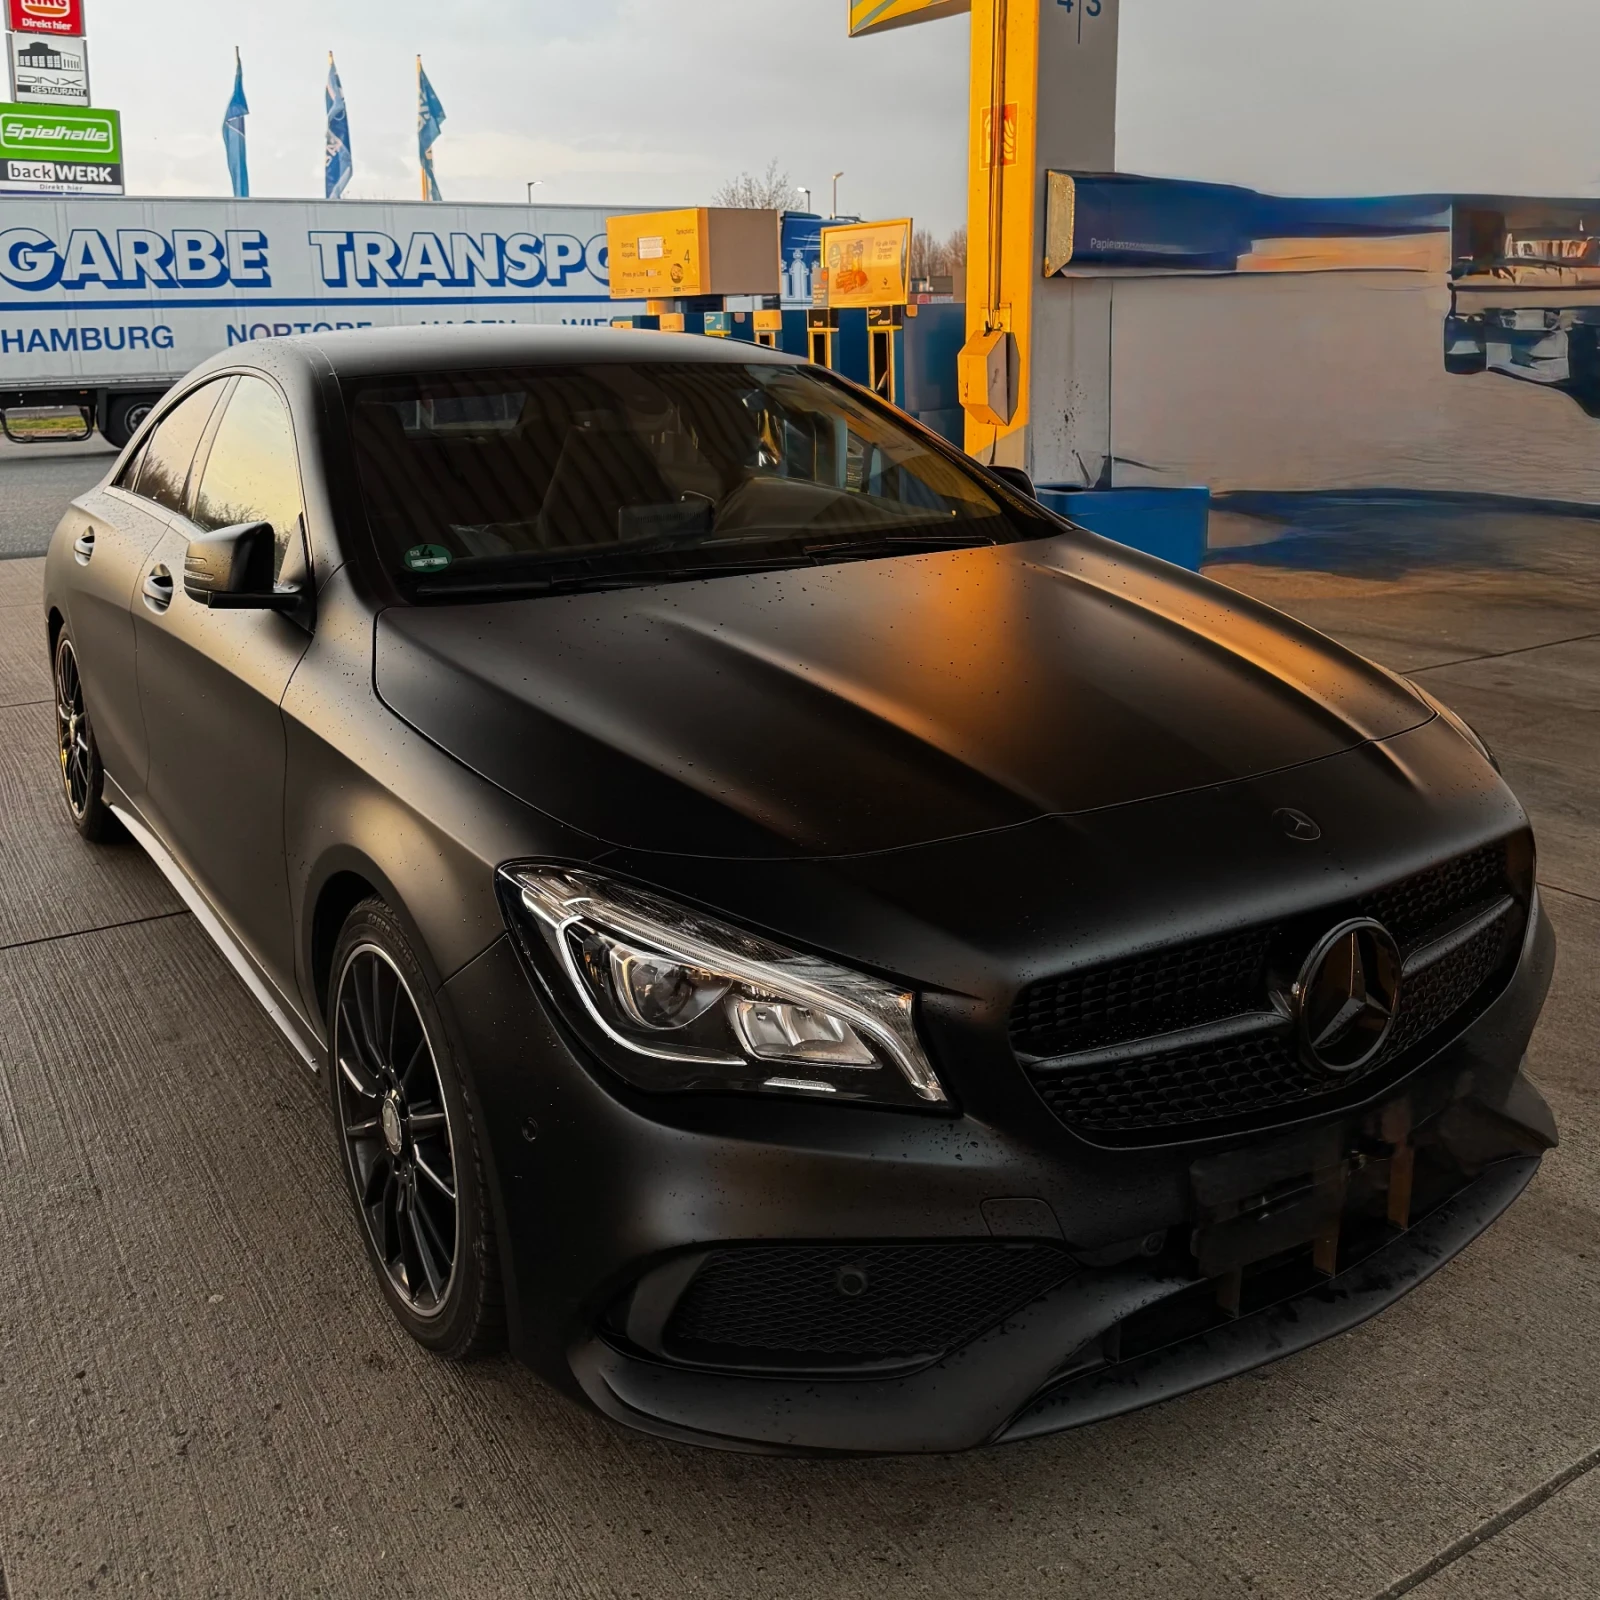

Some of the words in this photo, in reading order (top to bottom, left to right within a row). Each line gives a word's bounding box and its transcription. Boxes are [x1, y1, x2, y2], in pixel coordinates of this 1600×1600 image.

[21, 17, 52, 29] Direkt
[53, 20, 72, 31] hier
[17, 75, 83, 87] DINX
[30, 86, 84, 97] RESTAURANT
[4, 122, 109, 142] Spielhalle
[39, 183, 66, 191] Direkt
[67, 184, 83, 192] hier
[0, 227, 271, 291] GARBE
[683, 249, 691, 264] 4
[1, 325, 175, 353] HAMBURG
